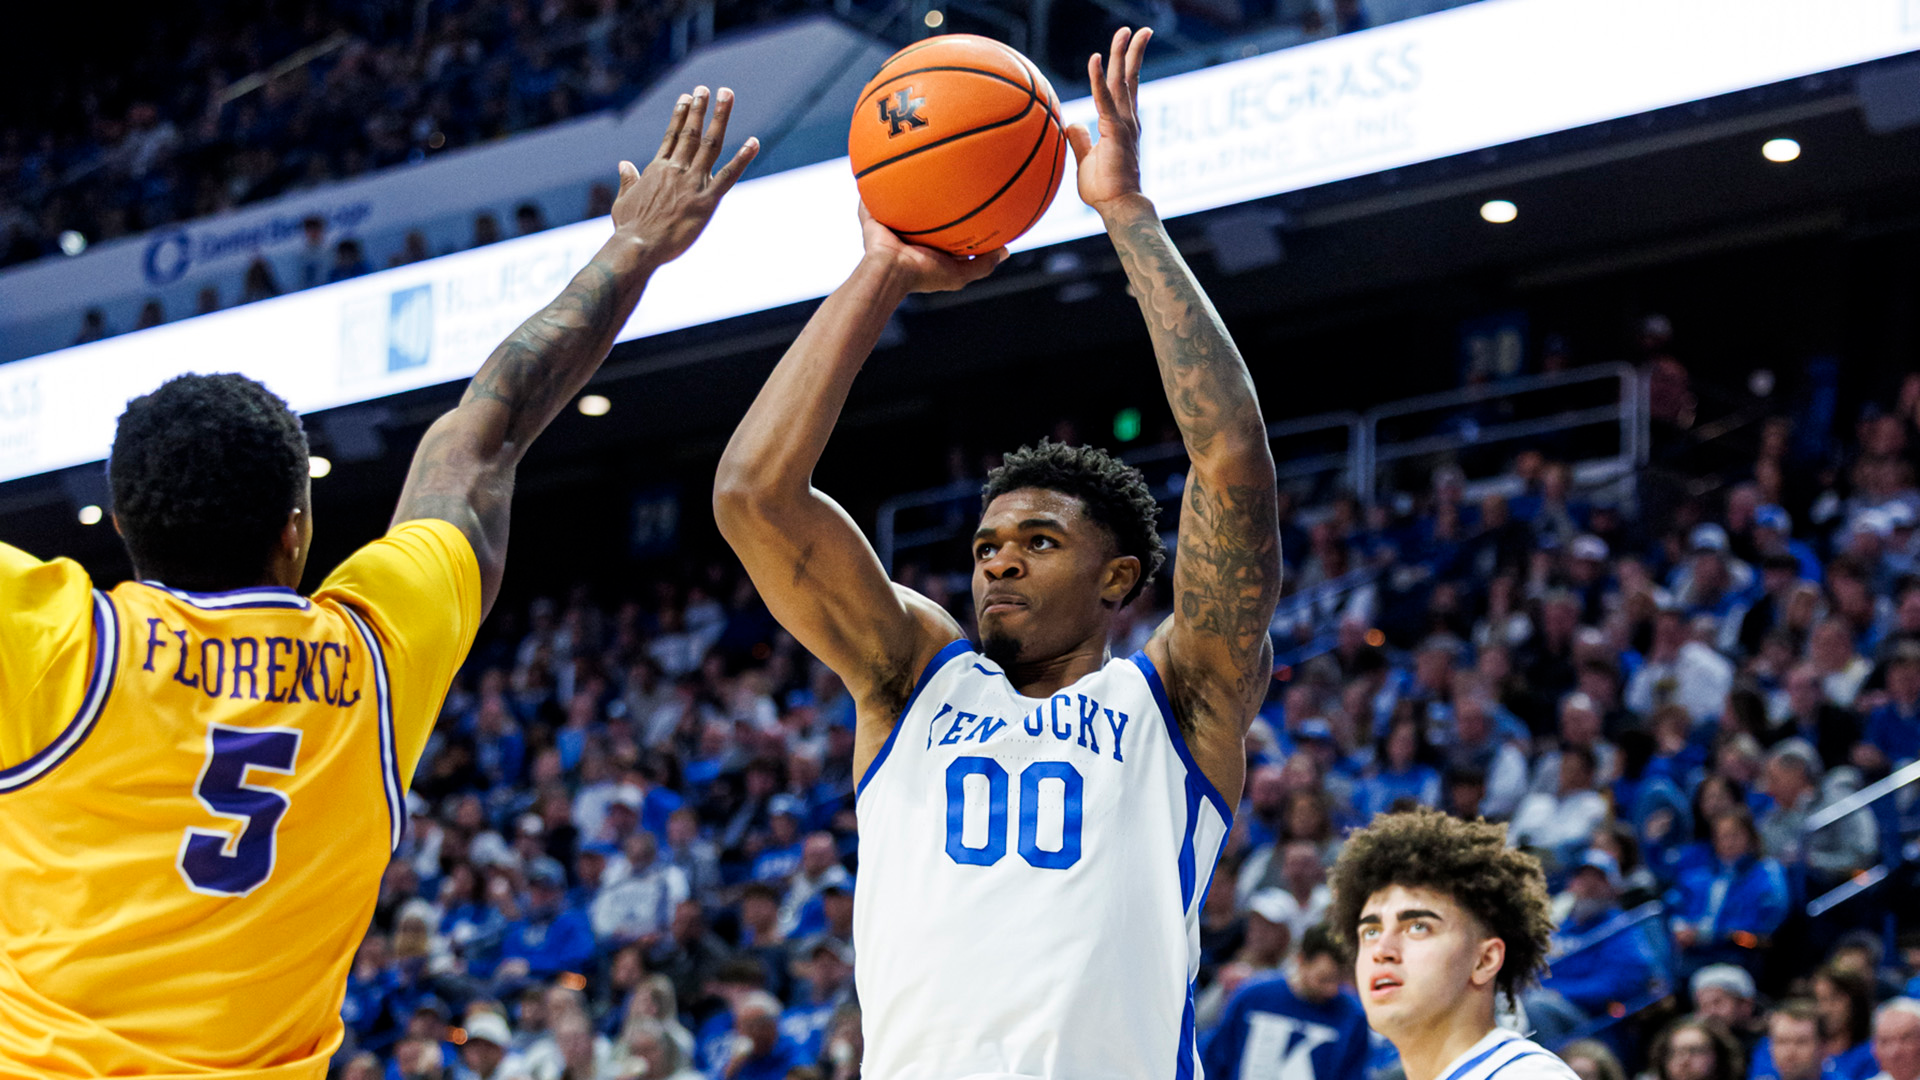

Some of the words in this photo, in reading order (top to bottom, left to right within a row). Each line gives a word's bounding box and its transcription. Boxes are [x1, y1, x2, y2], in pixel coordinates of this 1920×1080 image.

[1156, 40, 1423, 149] BLUEGRASS
[142, 617, 361, 708] FLORENCE
[926, 693, 1129, 763] ENUCKY
[176, 721, 304, 898] 5
[945, 756, 1084, 870] 00
